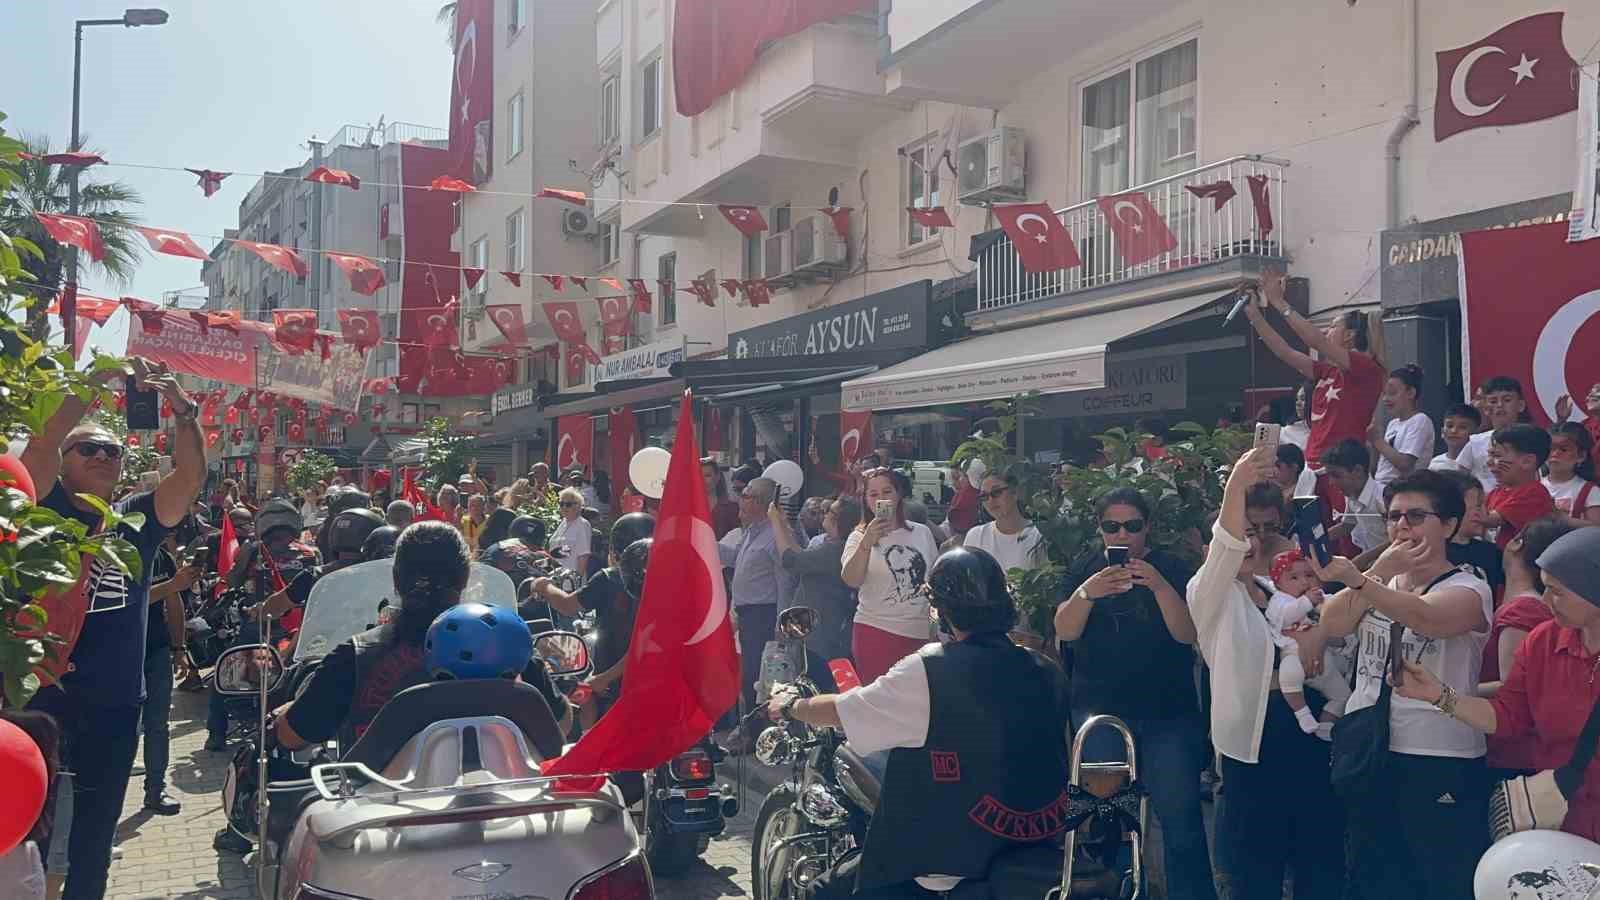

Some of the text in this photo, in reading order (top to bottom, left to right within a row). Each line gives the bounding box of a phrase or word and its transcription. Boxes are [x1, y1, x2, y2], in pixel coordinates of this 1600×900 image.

[803, 307, 878, 355] AYSUN
[934, 755, 957, 774] MC
[982, 798, 1067, 836] TURKIY
